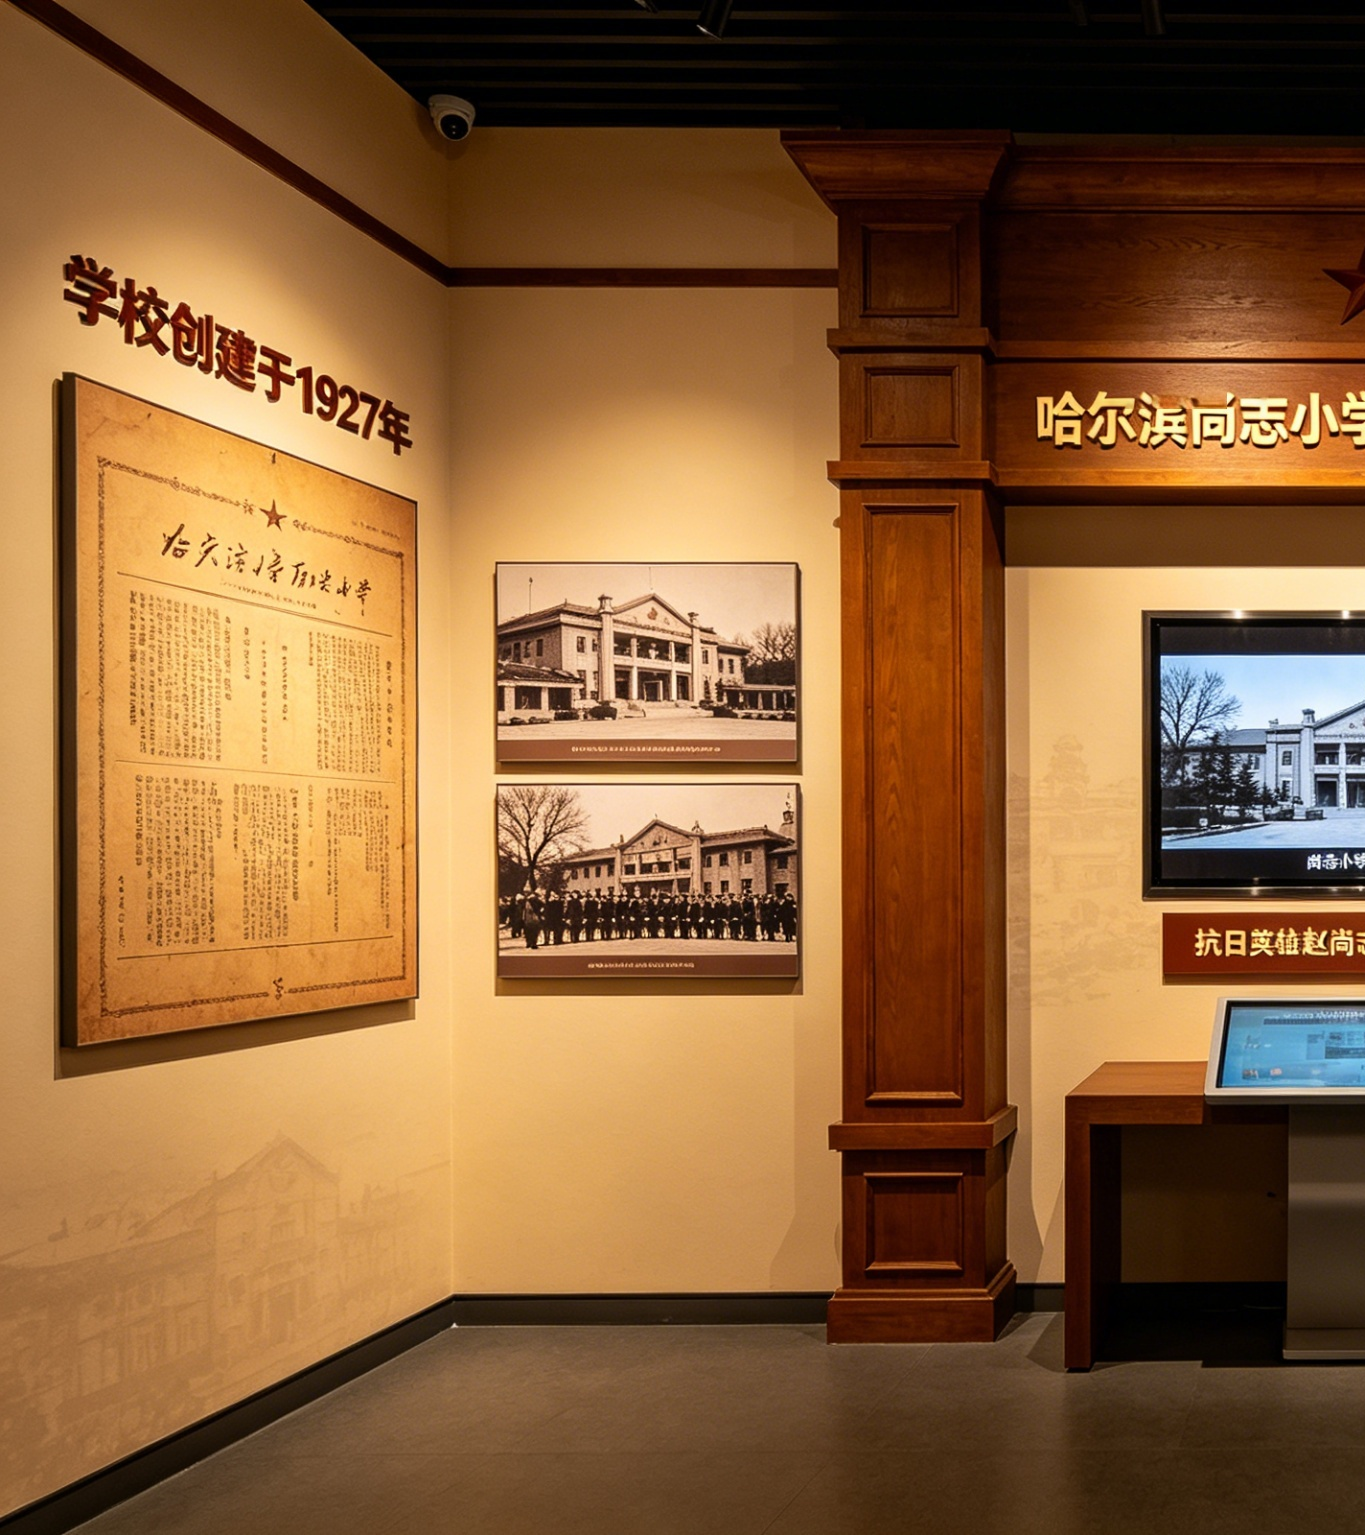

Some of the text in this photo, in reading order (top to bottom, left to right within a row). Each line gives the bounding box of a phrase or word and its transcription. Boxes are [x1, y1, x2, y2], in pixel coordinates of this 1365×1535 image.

[62, 254, 413, 456] 学校创建于1927年
